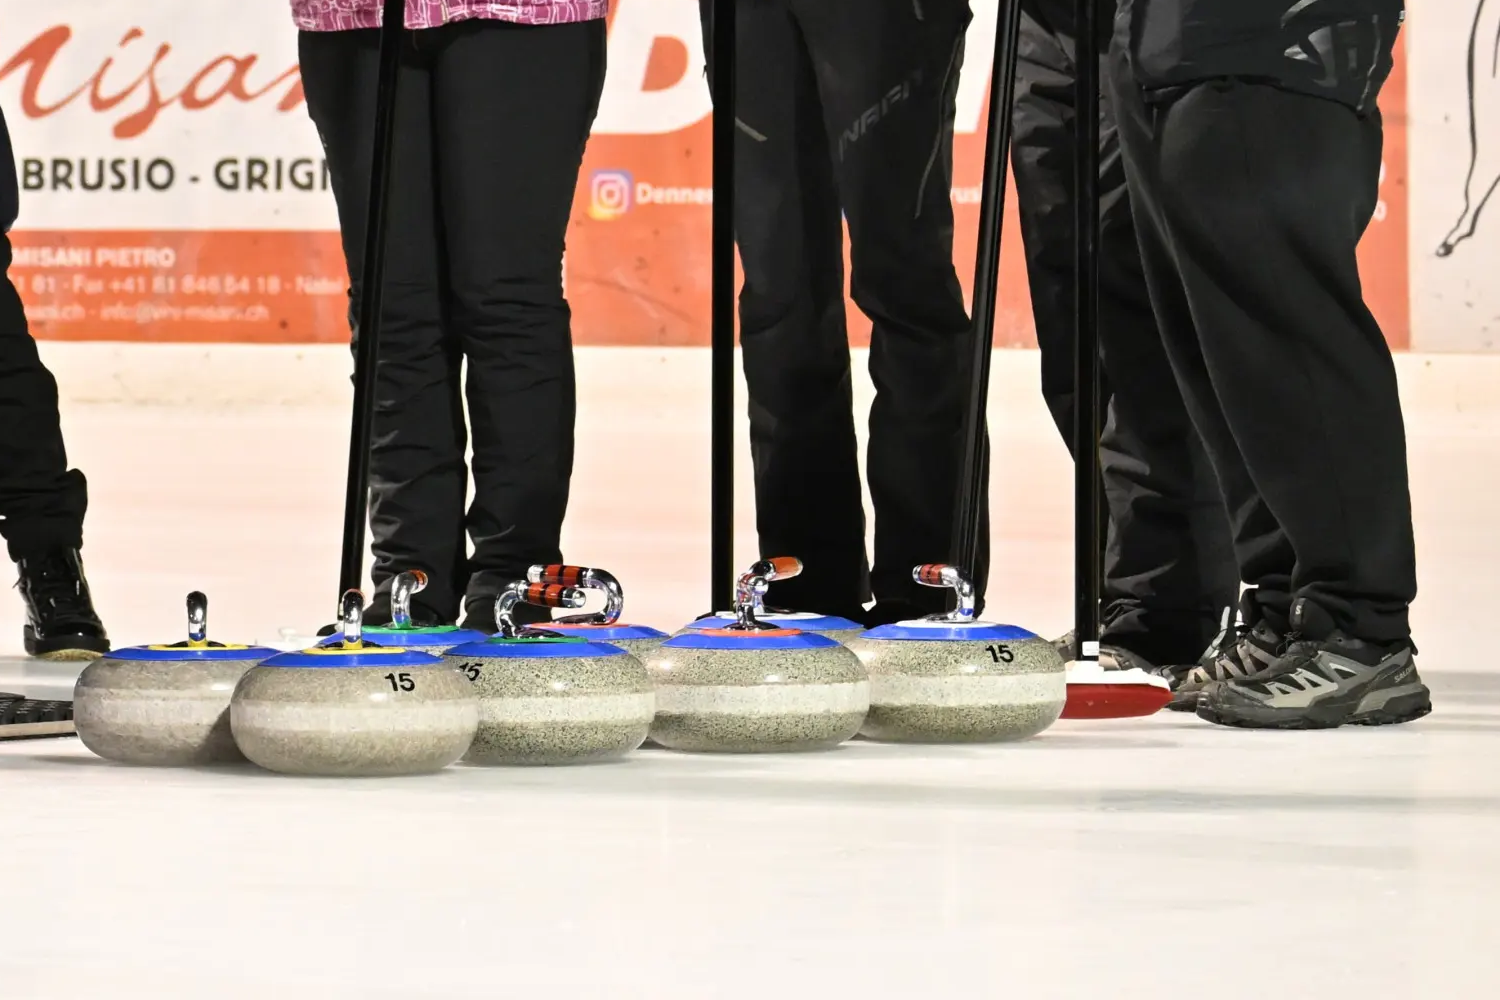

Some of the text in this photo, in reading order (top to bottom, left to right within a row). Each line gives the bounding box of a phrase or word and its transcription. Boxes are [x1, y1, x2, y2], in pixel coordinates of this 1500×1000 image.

[22, 157, 176, 192] BRUSIO
[11, 247, 177, 268] MISANI PIETRO
[985, 644, 1015, 663] 15
[384, 672, 416, 692] 15
